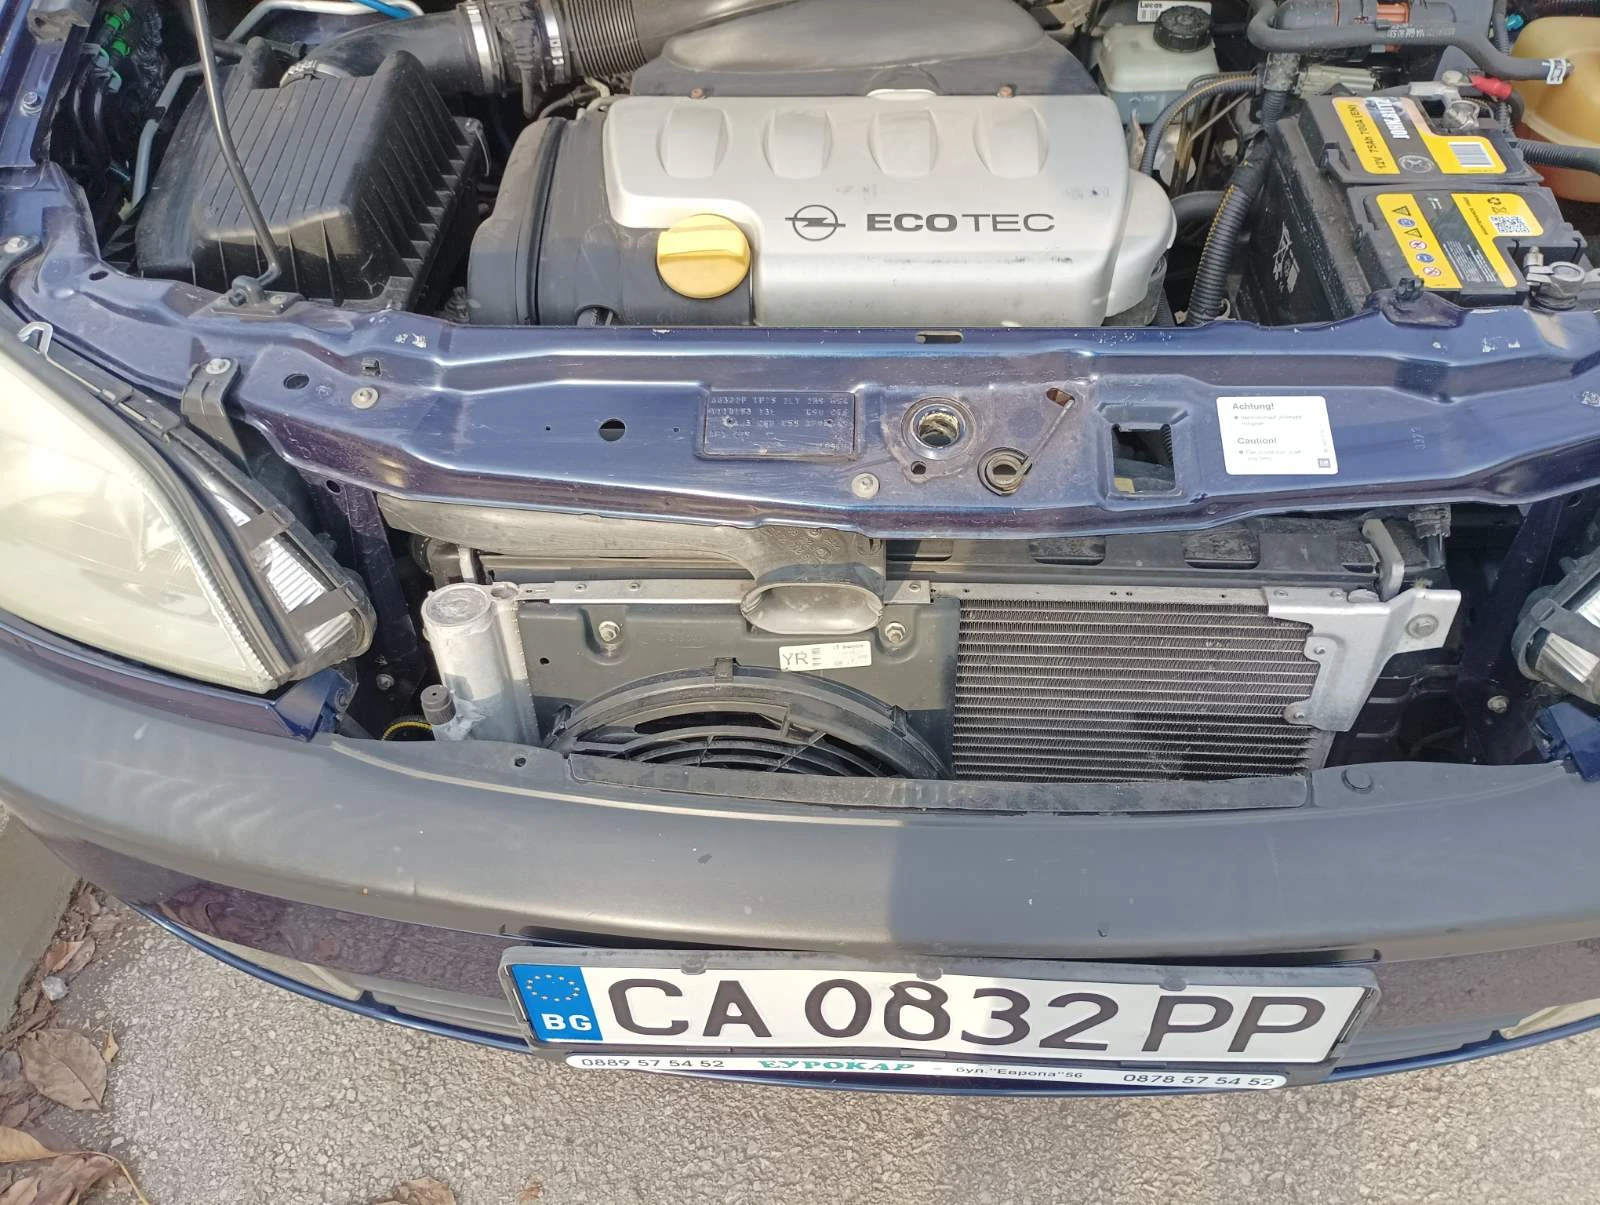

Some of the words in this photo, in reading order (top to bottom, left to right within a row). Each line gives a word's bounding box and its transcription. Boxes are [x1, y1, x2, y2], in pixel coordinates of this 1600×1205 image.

[866, 213, 1055, 232] ECOTEC
[1232, 402, 1275, 411] Achtung!
[1237, 437, 1277, 445] Caution!
[541, 1013, 592, 1031] BG
[608, 978, 772, 1037] CA
[804, 978, 1119, 1051] 0832
[1141, 995, 1326, 1053] PP
[581, 1058, 630, 1067] 0889
[638, 1059, 660, 1067] 57
[669, 1059, 692, 1068] 54
[700, 1060, 725, 1068] 52
[1123, 1074, 1175, 1083] 0878
[1182, 1076, 1208, 1084] 57
[1215, 1077, 1240, 1085] 54
[1248, 1078, 1275, 1086] 52
